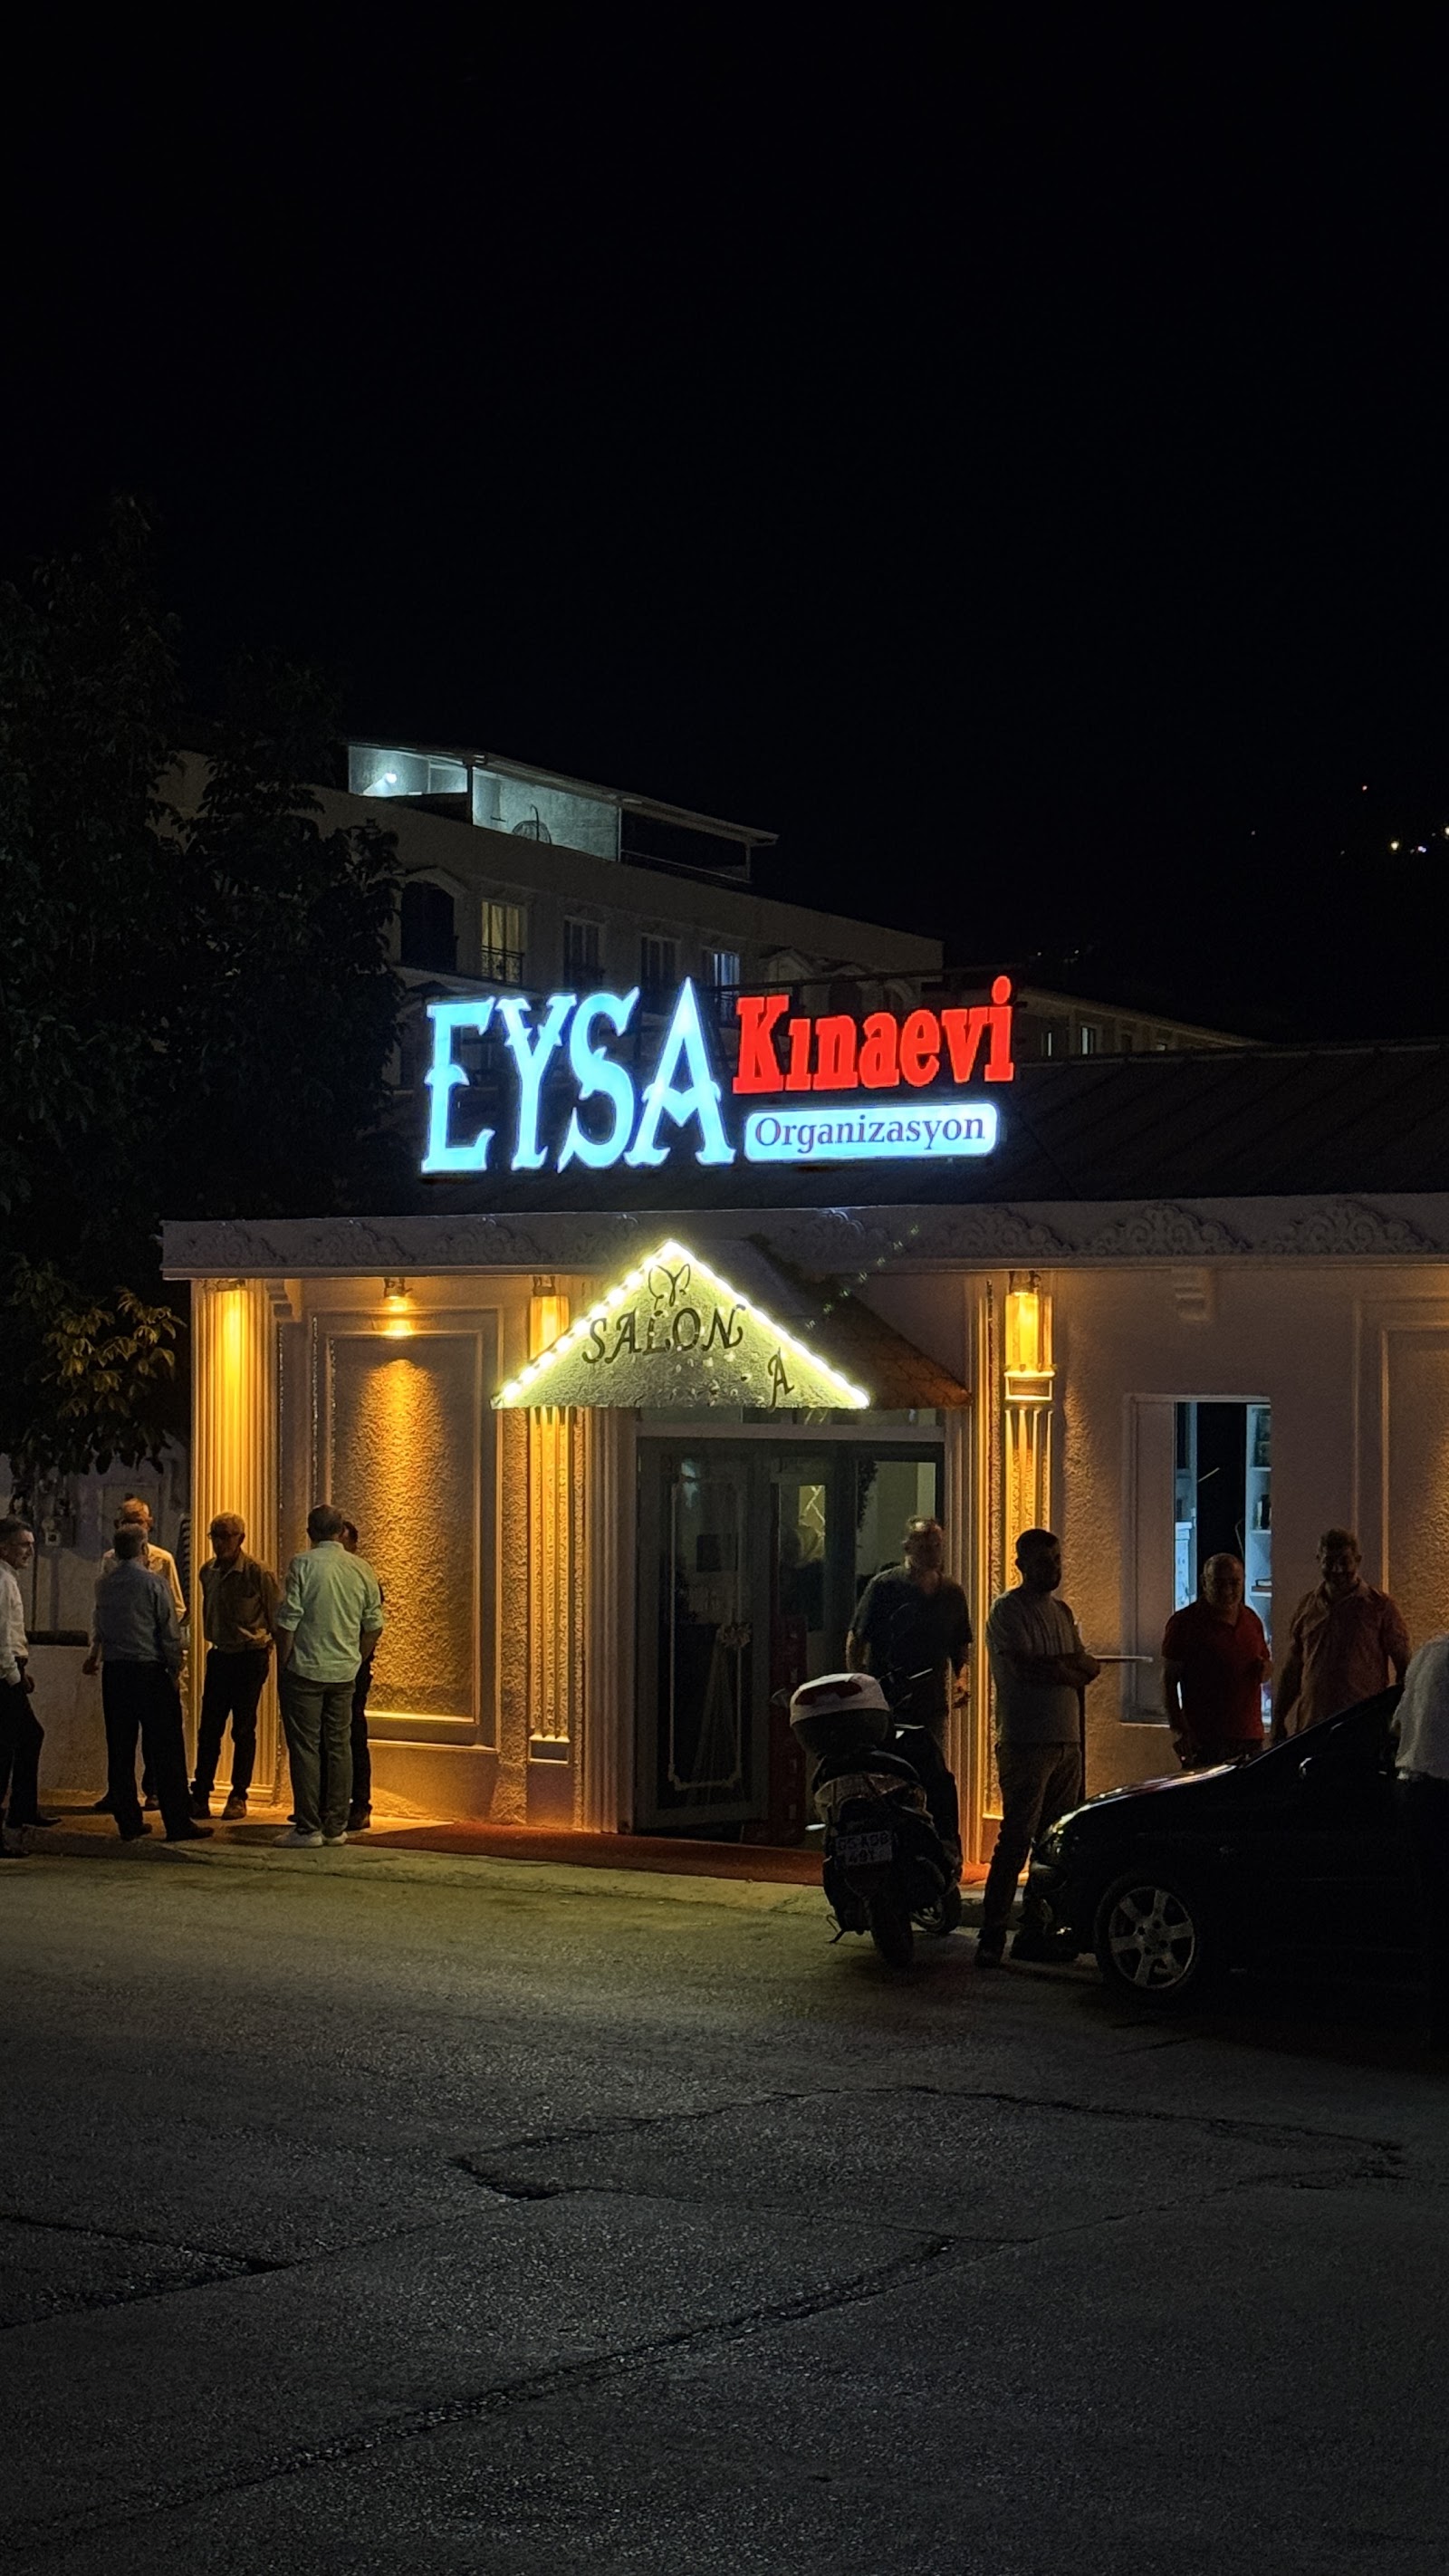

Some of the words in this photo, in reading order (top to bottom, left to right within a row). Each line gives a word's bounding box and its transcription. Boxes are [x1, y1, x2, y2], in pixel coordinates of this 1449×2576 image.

[421, 976, 735, 1173] EYSA
[733, 976, 1014, 1094] Kınaevi
[754, 1115, 986, 1154] Organizasyon
[581, 1303, 746, 1365] SALON
